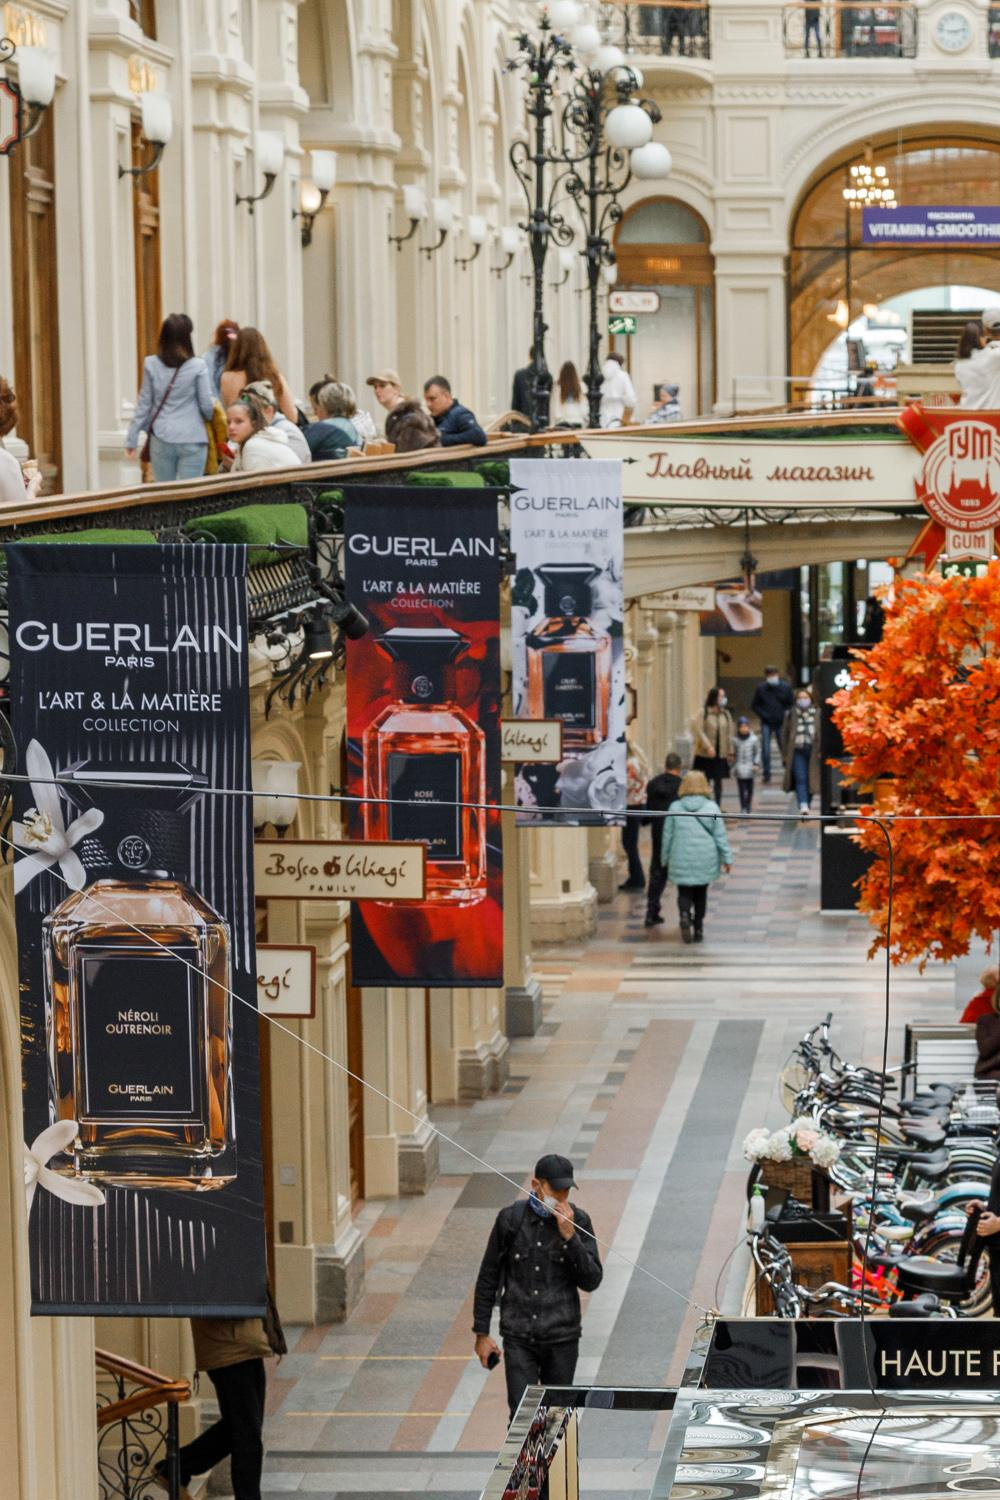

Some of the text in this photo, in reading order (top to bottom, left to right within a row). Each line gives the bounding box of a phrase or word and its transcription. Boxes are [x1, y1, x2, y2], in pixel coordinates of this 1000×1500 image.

[869, 223, 926, 236] VITAMIN
[646, 452, 874, 482] Главный магазин
[515, 496, 619, 510] GUERLAIN
[928, 499, 967, 529] КРАСНАЯ
[349, 534, 494, 556] GUERLAIN
[952, 534, 985, 549] GUM
[363, 579, 480, 594] L'ART & LA MATIÈRE
[391, 598, 453, 608] COLLECTION
[16, 620, 242, 653] GUERLAIN
[105, 656, 155, 668] PARIS
[38, 689, 222, 711] L'ART & LA MATIÈRE
[83, 718, 179, 732] COLLECTION
[415, 790, 433, 798] ROSE
[265, 853, 319, 882] Bosco
[118, 1009, 159, 1023] NÉROLI
[106, 1023, 172, 1035] OUTRENOIR
[108, 1084, 173, 1095] GUERLAIN
[881, 1350, 981, 1377] HAUTE
